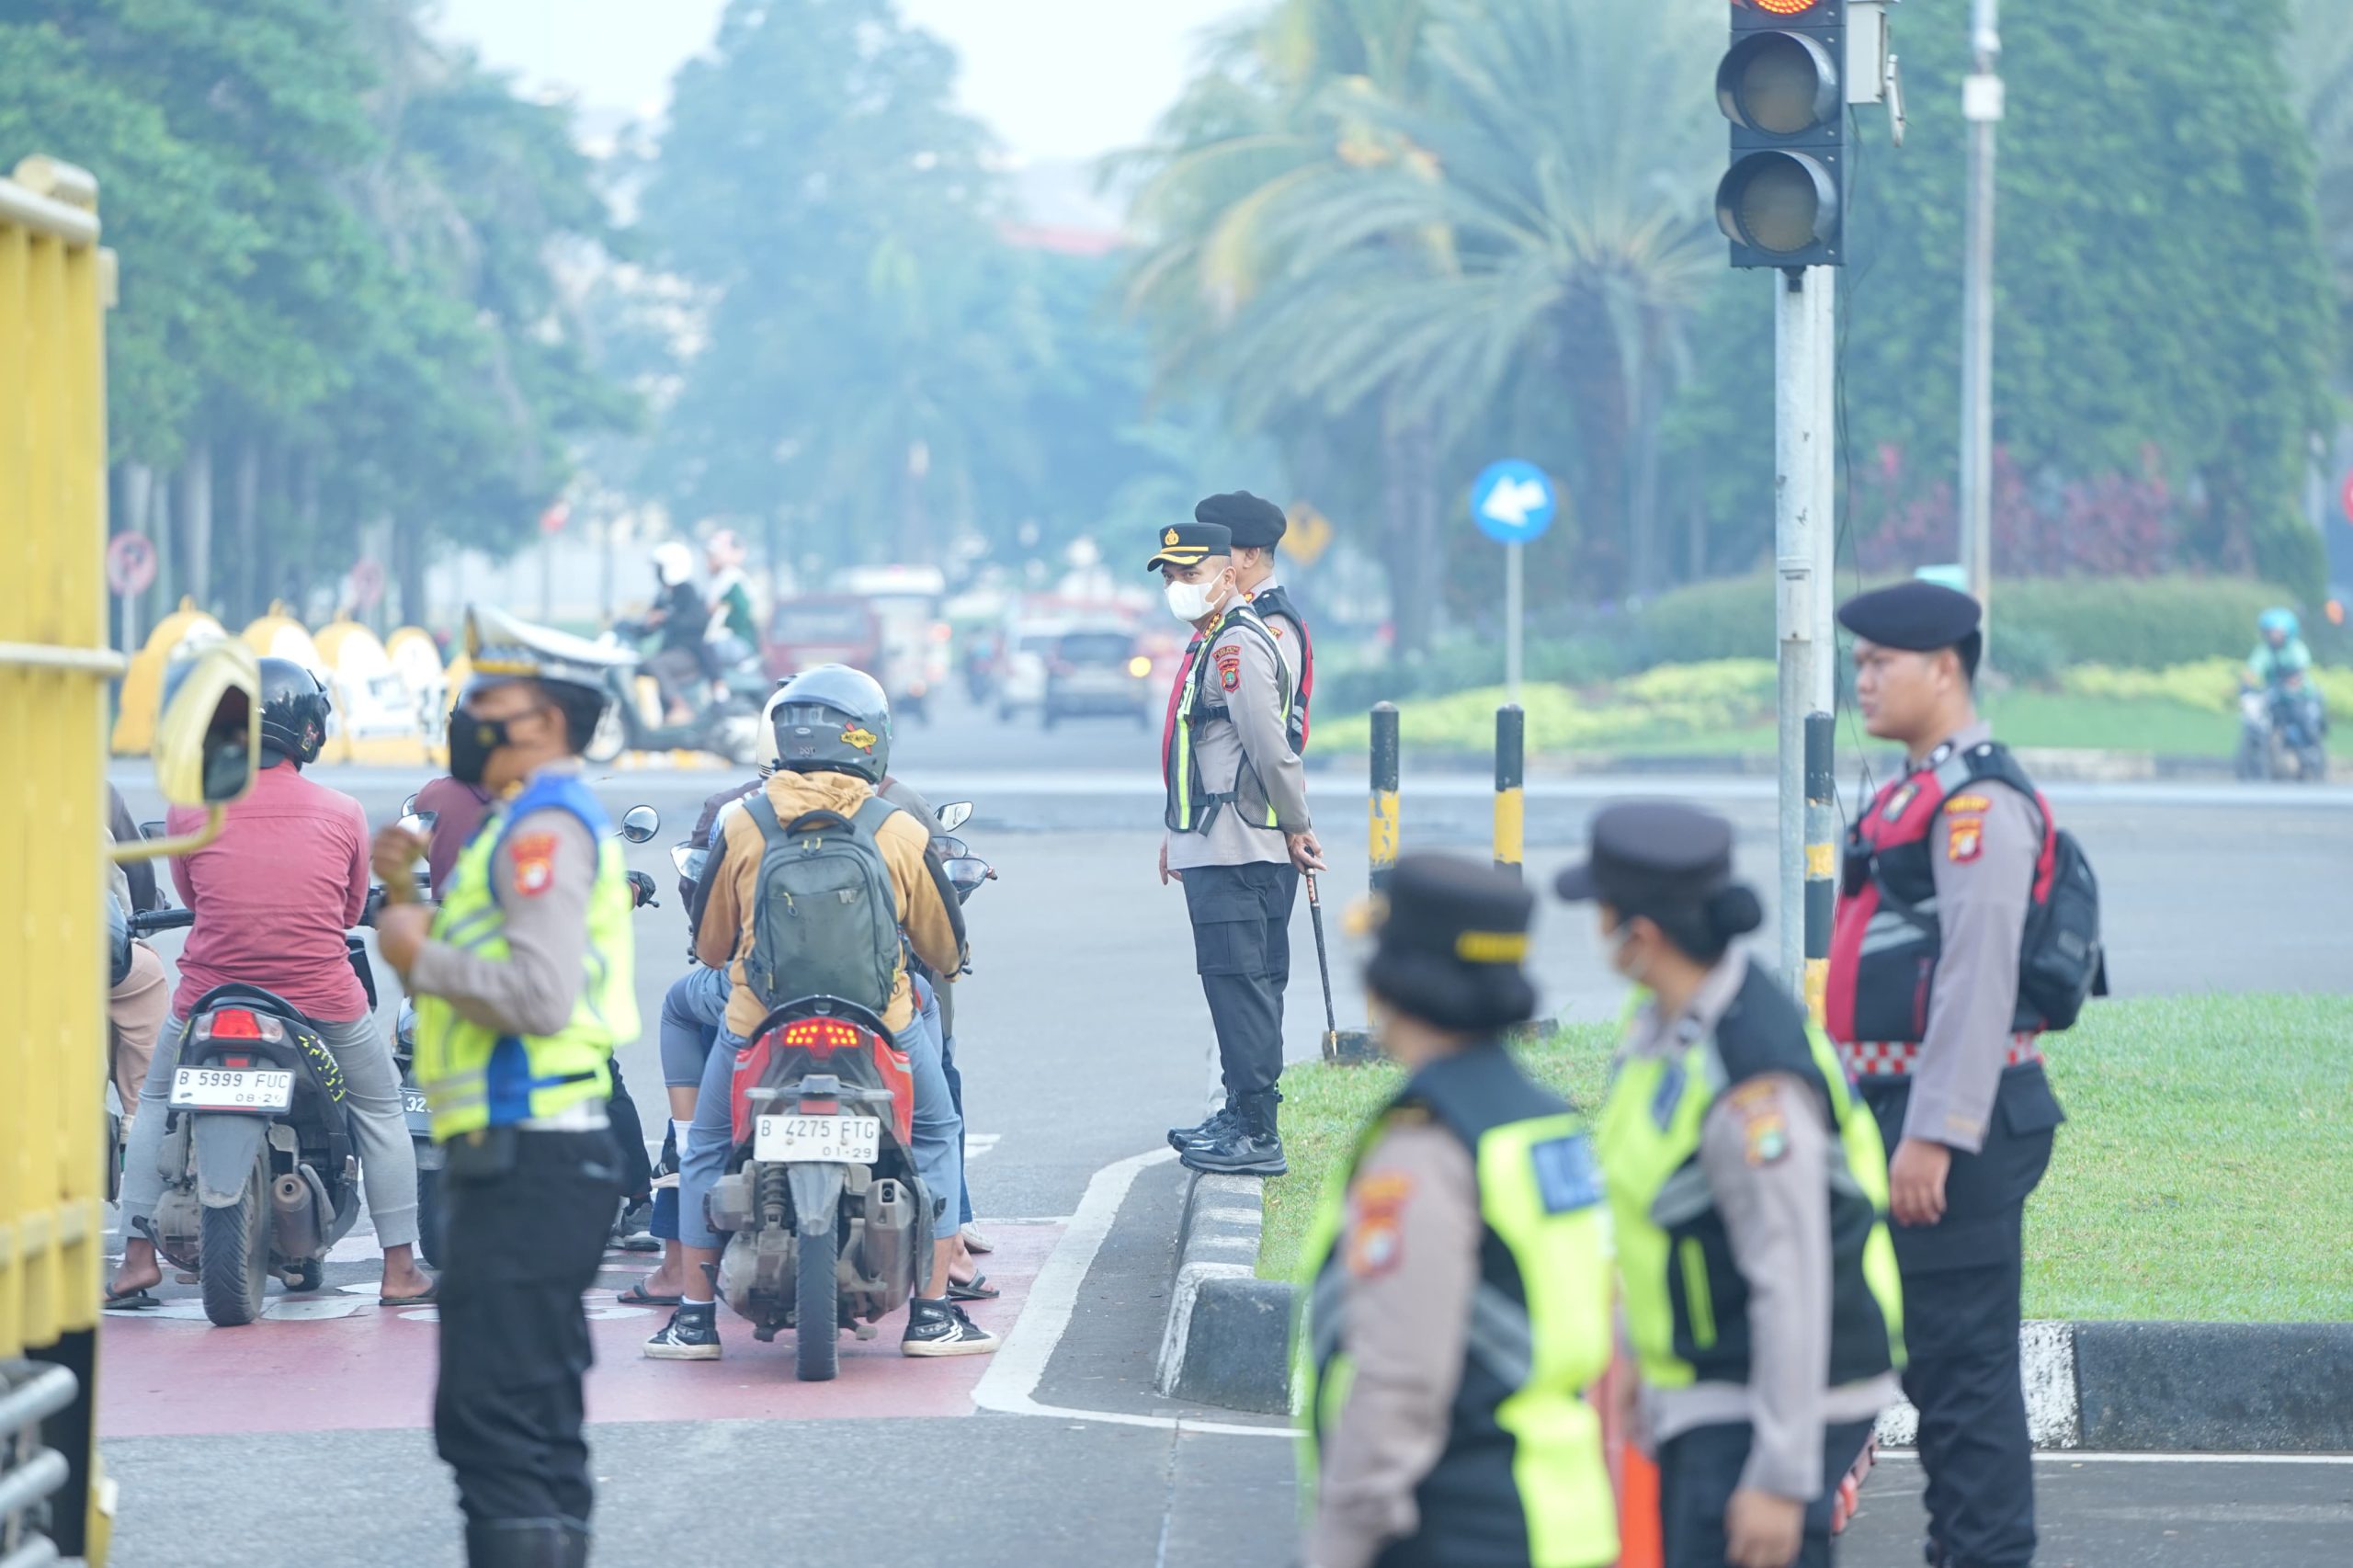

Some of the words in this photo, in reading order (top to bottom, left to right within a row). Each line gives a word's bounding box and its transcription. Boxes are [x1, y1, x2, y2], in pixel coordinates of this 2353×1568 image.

[179, 1071, 189, 1085] B
[199, 1072, 243, 1087] 5999
[255, 1074, 288, 1088] FUC
[405, 1096, 432, 1113] 32
[761, 1119, 771, 1137] B
[785, 1120, 830, 1138] 4275
[842, 1121, 874, 1139] FTG
[823, 1146, 871, 1158] 01-29
